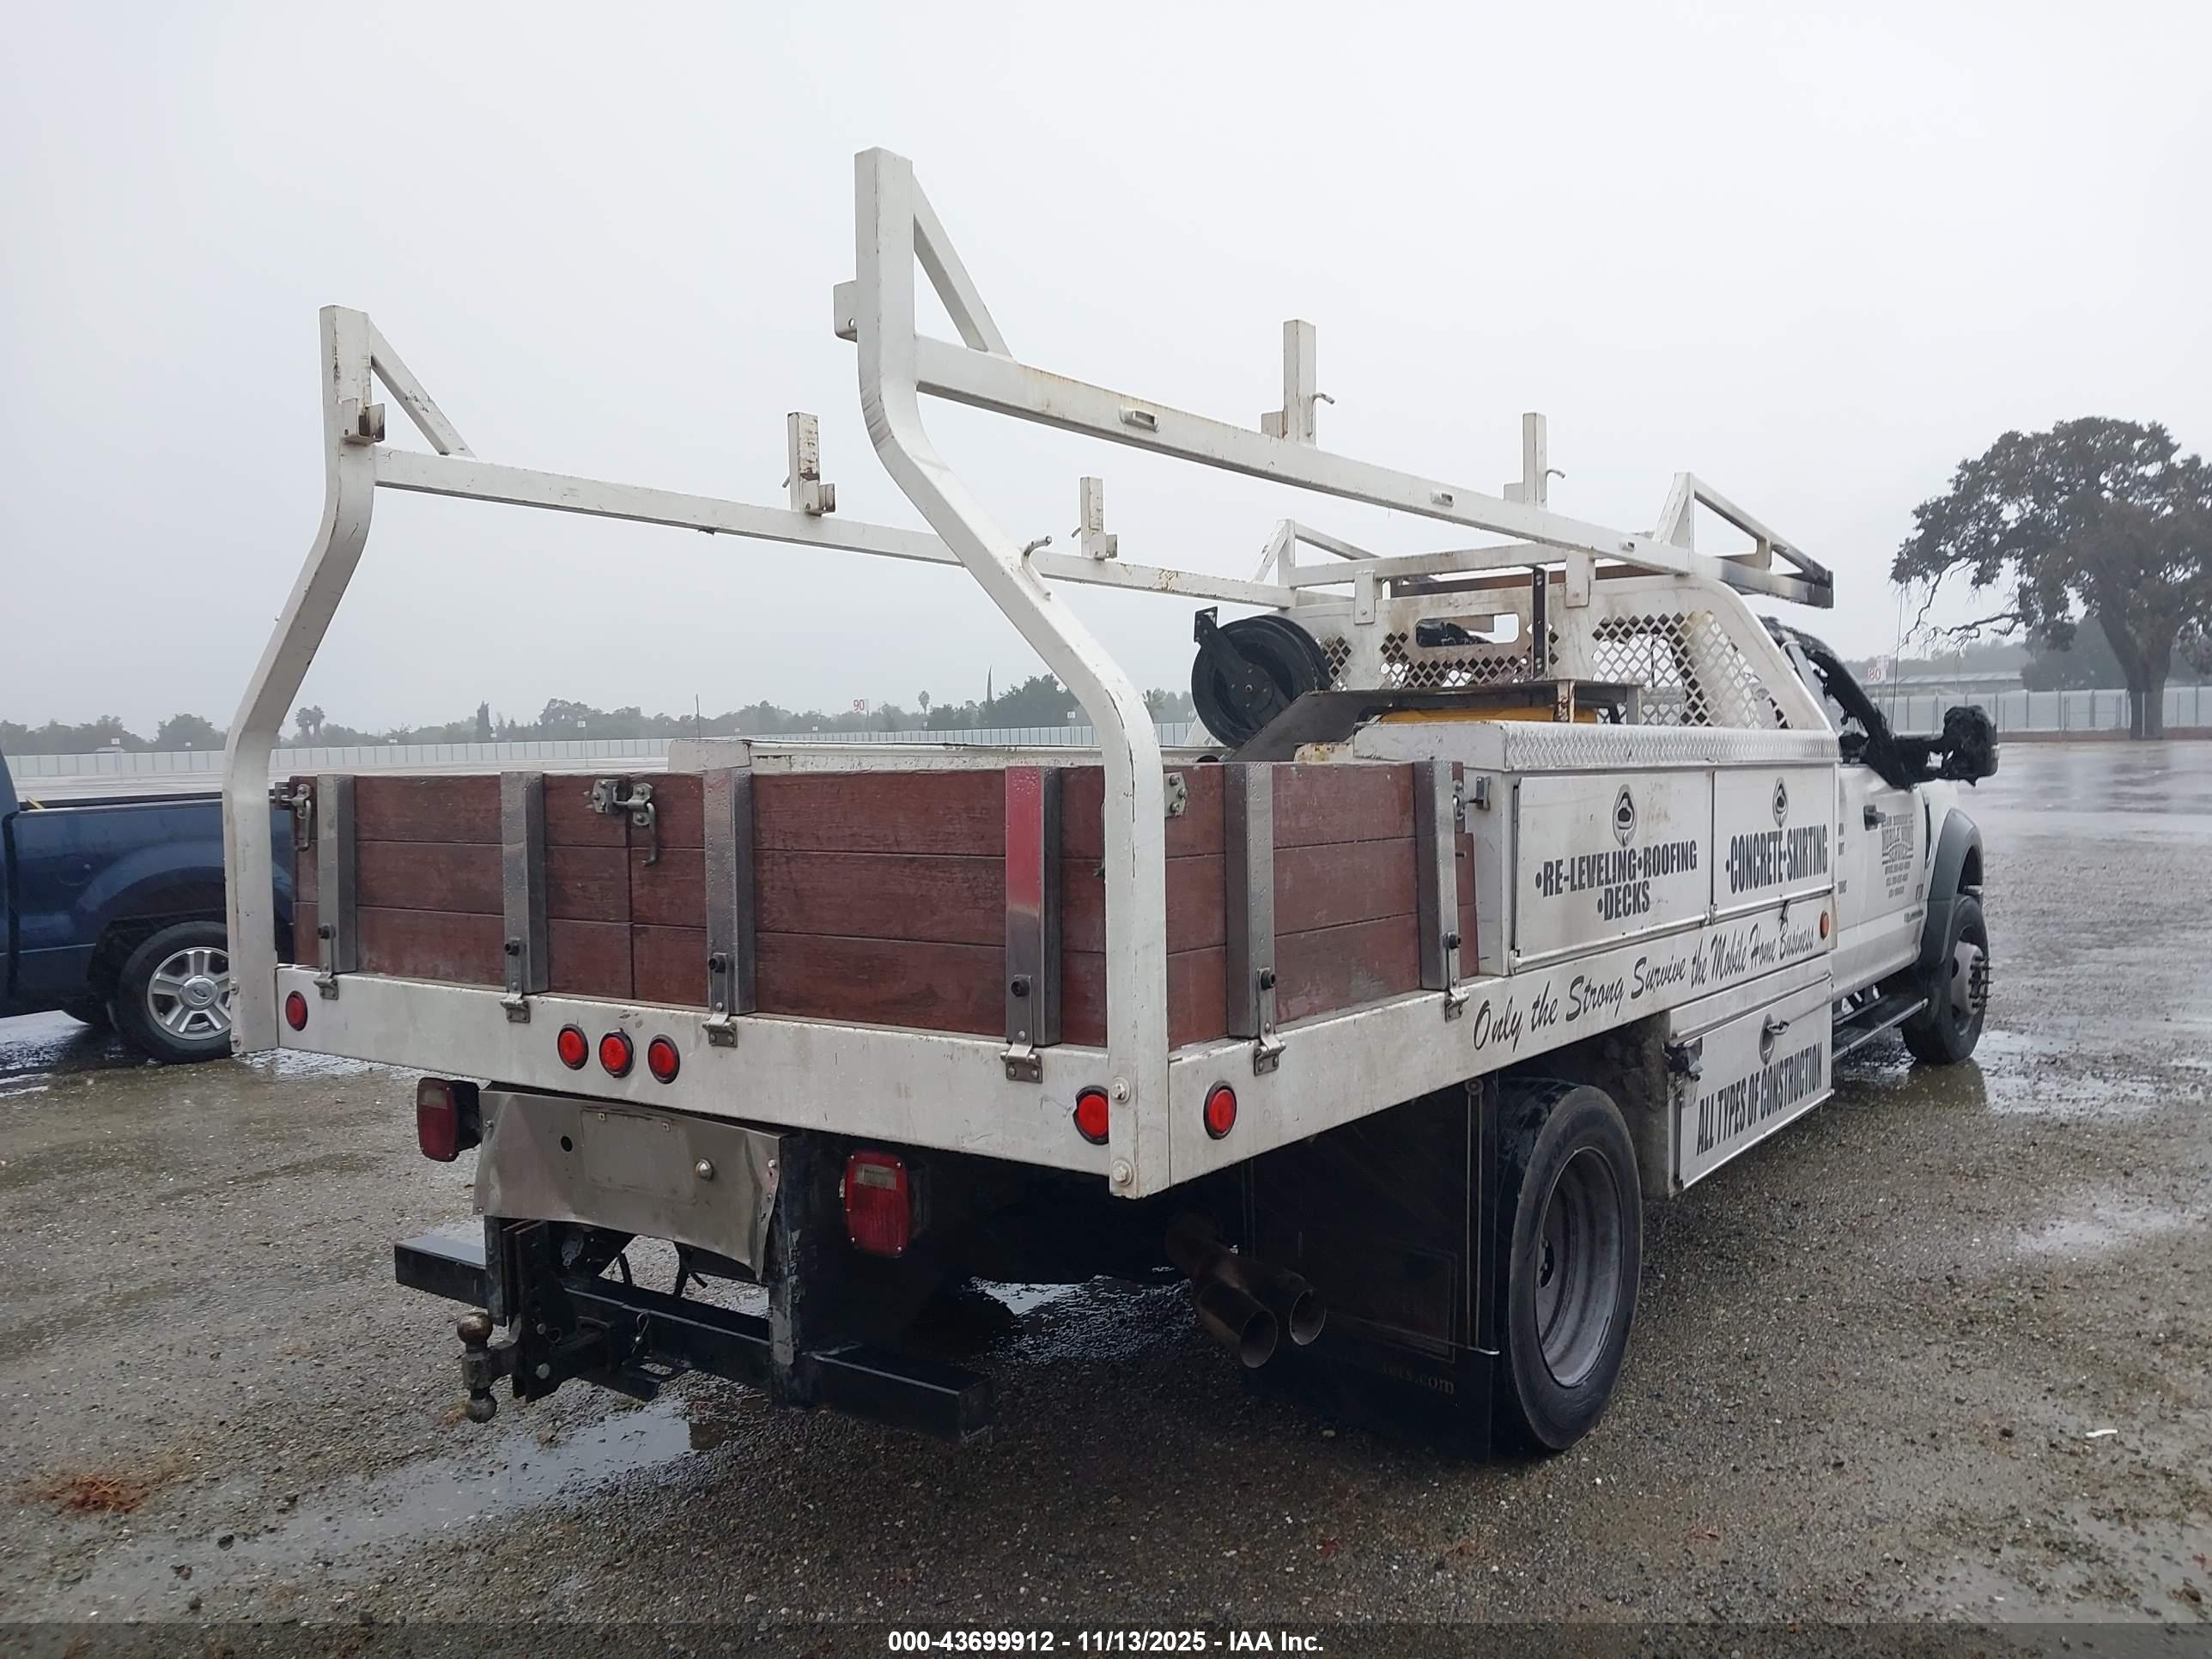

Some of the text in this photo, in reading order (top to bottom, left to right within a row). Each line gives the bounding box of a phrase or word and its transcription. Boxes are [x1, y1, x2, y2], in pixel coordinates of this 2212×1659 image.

[853, 699, 866, 711] 90
[1643, 840, 1698, 879] ROOFING
[1730, 823, 1828, 894] CONCRETE SKIRTING
[1604, 880, 1650, 921] DECKS
[1473, 921, 1814, 1052] Only the Strong Survive the Mobile Home Business
[1697, 1042, 1823, 1156] ALL TYPES OF CONSTRUCTION
